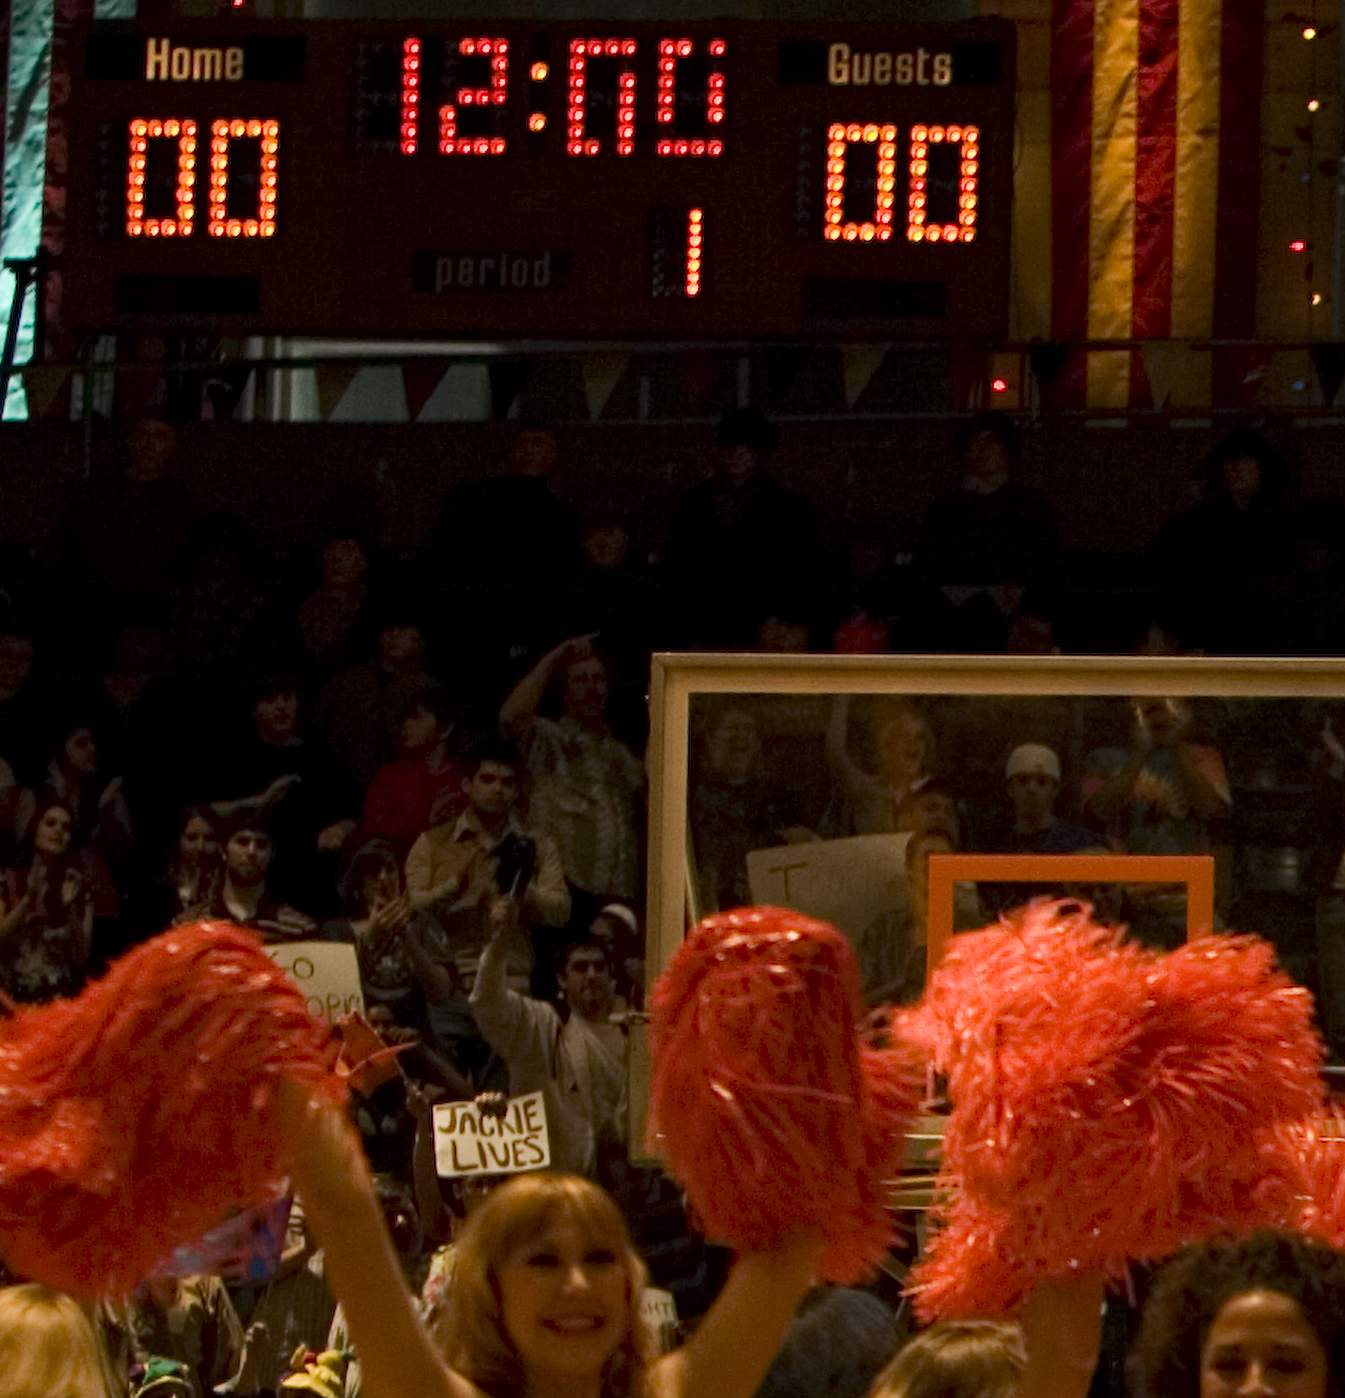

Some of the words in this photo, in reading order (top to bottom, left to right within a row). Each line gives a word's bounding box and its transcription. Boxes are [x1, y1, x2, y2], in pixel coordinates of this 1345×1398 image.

[146, 37, 244, 81] Home
[827, 41, 953, 87] Guests
[126, 117, 280, 238] 00
[823, 121, 981, 243] 00
[435, 250, 552, 293] period
[684, 207, 705, 298] 1
[436, 1099, 542, 1137] JACKIE
[451, 1134, 545, 1171] LIVES
